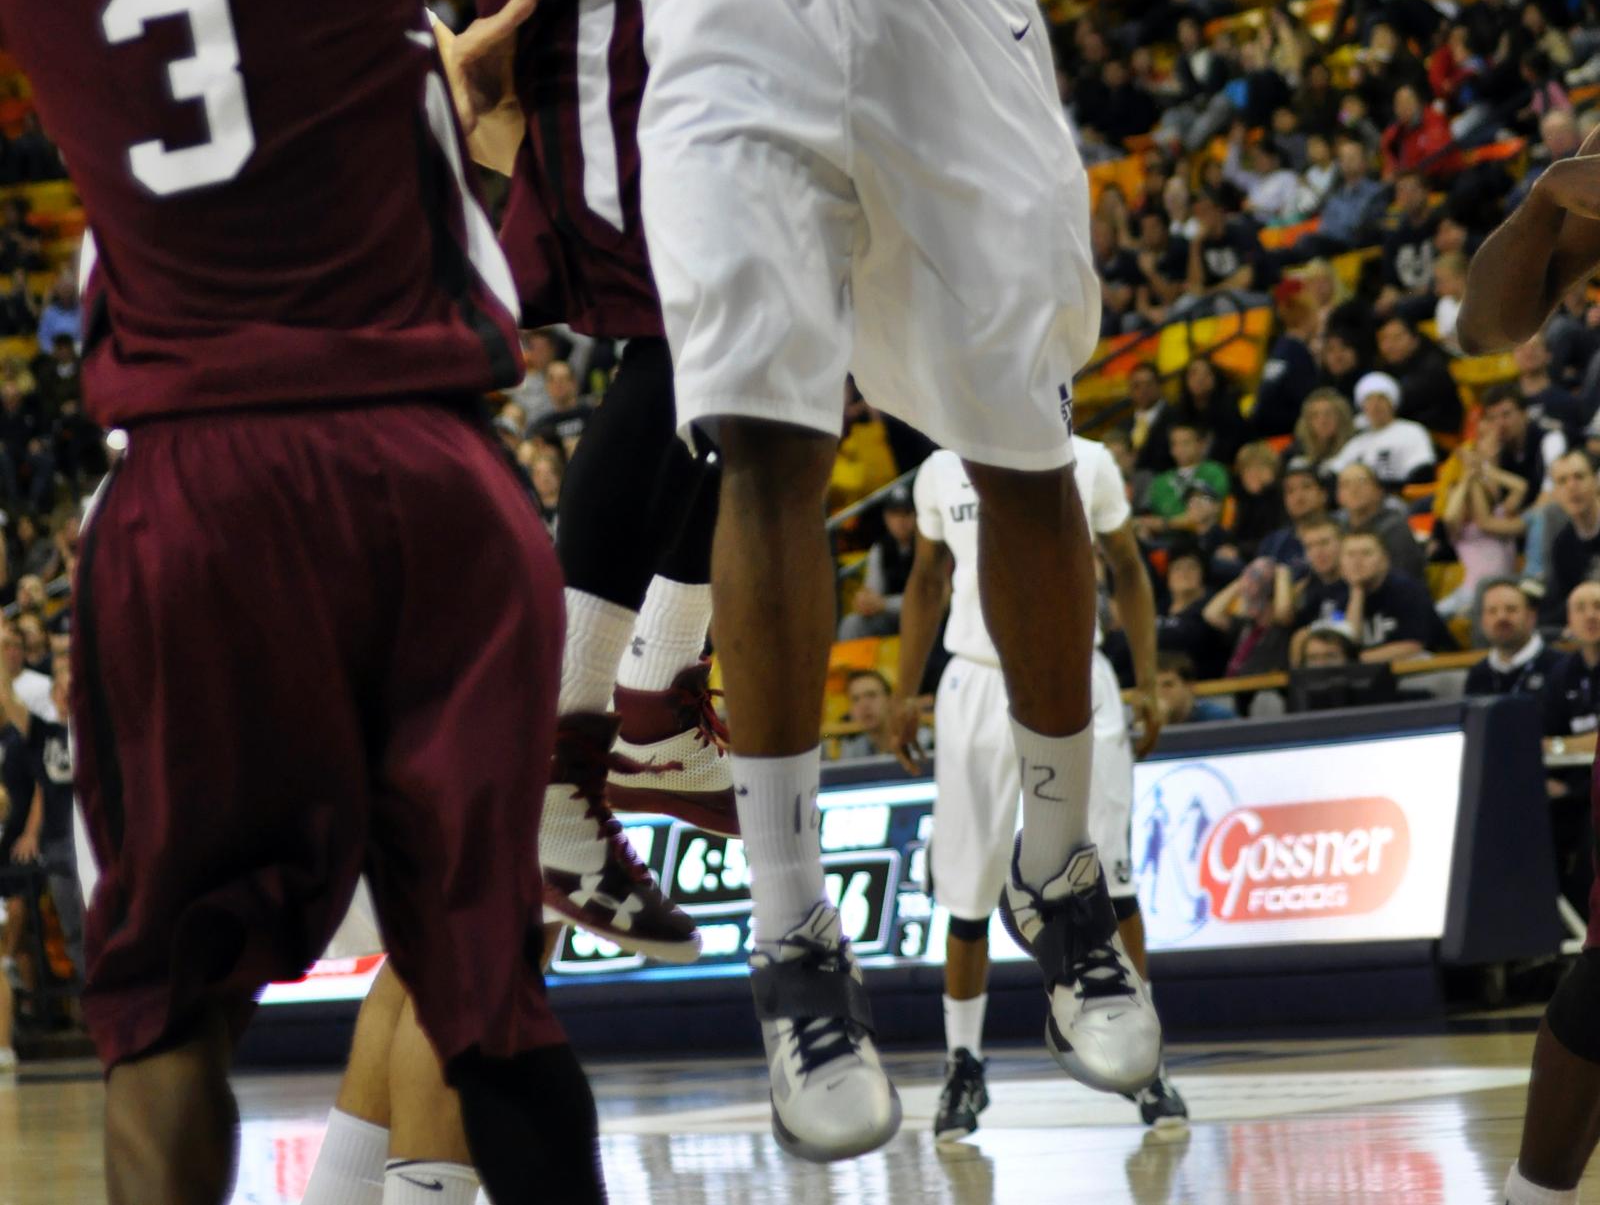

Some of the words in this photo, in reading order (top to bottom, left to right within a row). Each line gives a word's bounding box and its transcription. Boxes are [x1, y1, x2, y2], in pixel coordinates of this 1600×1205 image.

[950, 503, 978, 523] UT
[1021, 756, 1068, 802] 12
[677, 837, 753, 893] 6:5
[1208, 810, 1384, 917] Gossner
[1248, 883, 1348, 912] FOODS
